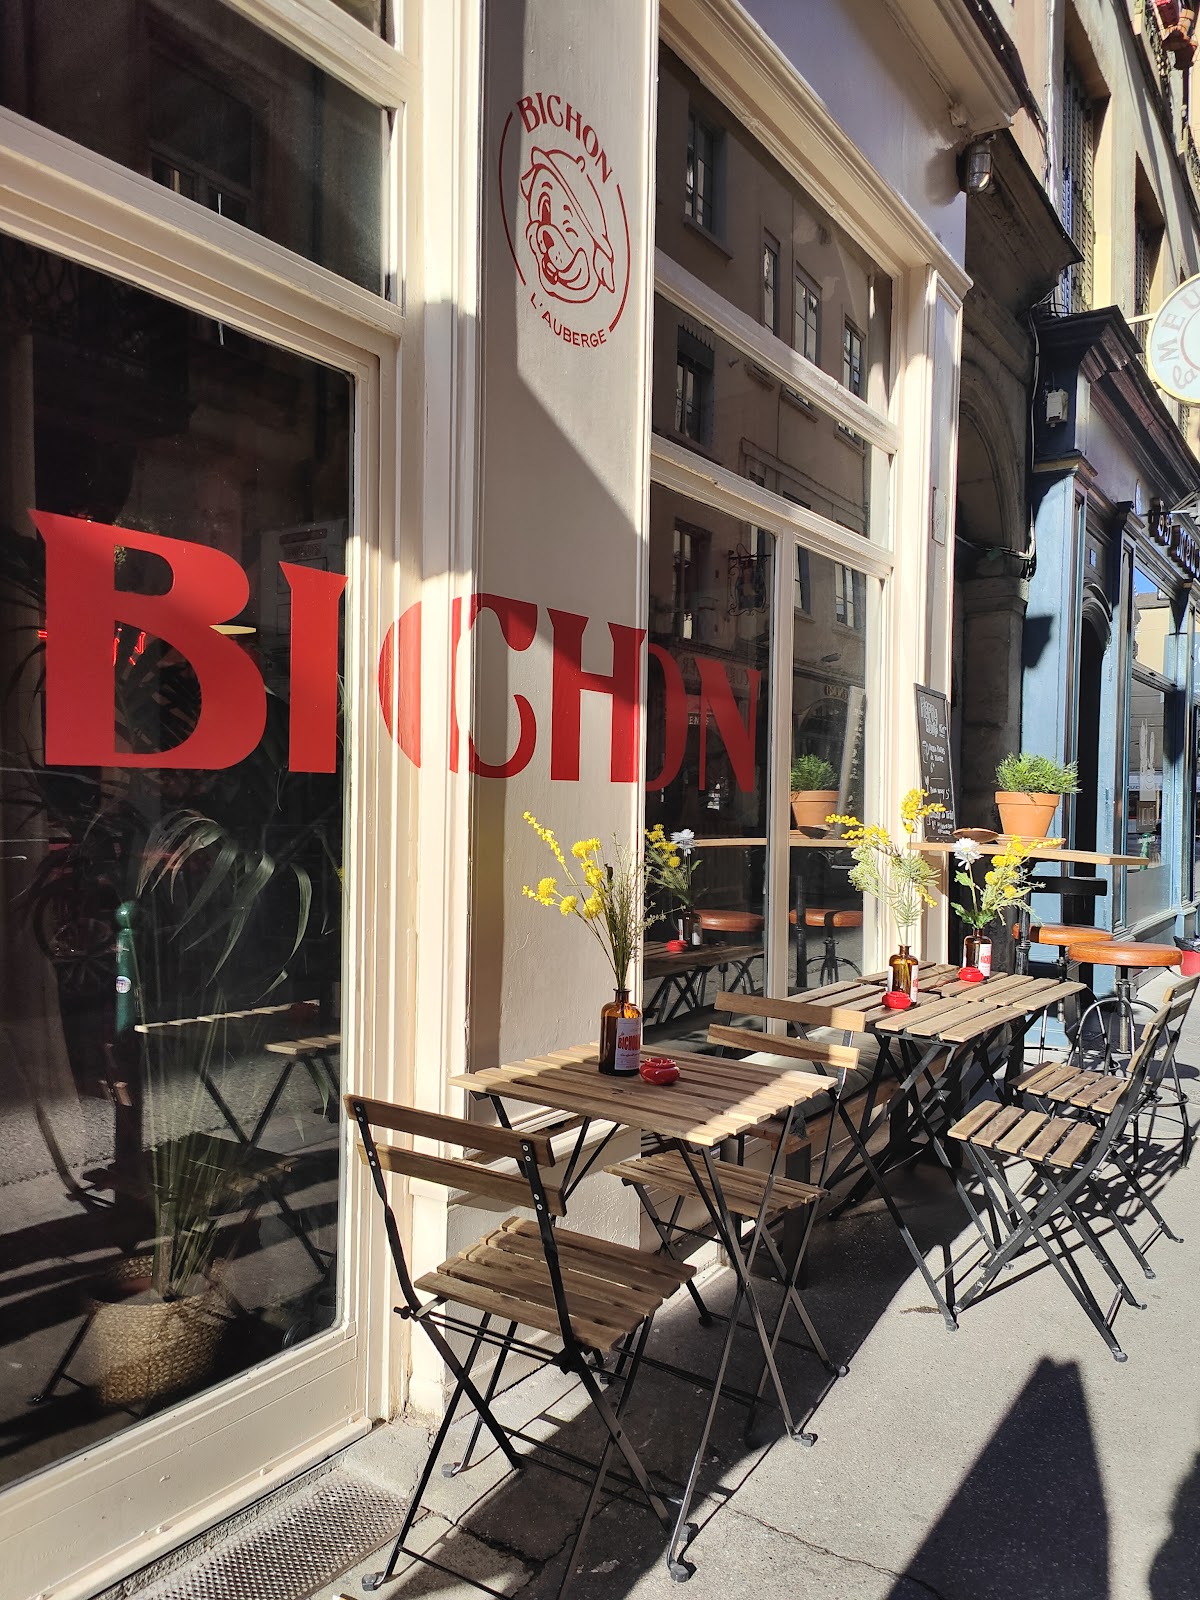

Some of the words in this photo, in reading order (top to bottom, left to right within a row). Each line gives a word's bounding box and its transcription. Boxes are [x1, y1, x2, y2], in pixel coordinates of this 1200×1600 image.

[516, 92, 613, 184] BICHON
[530, 292, 607, 348] L'AUBERGE
[28, 509, 762, 792] BICHON
